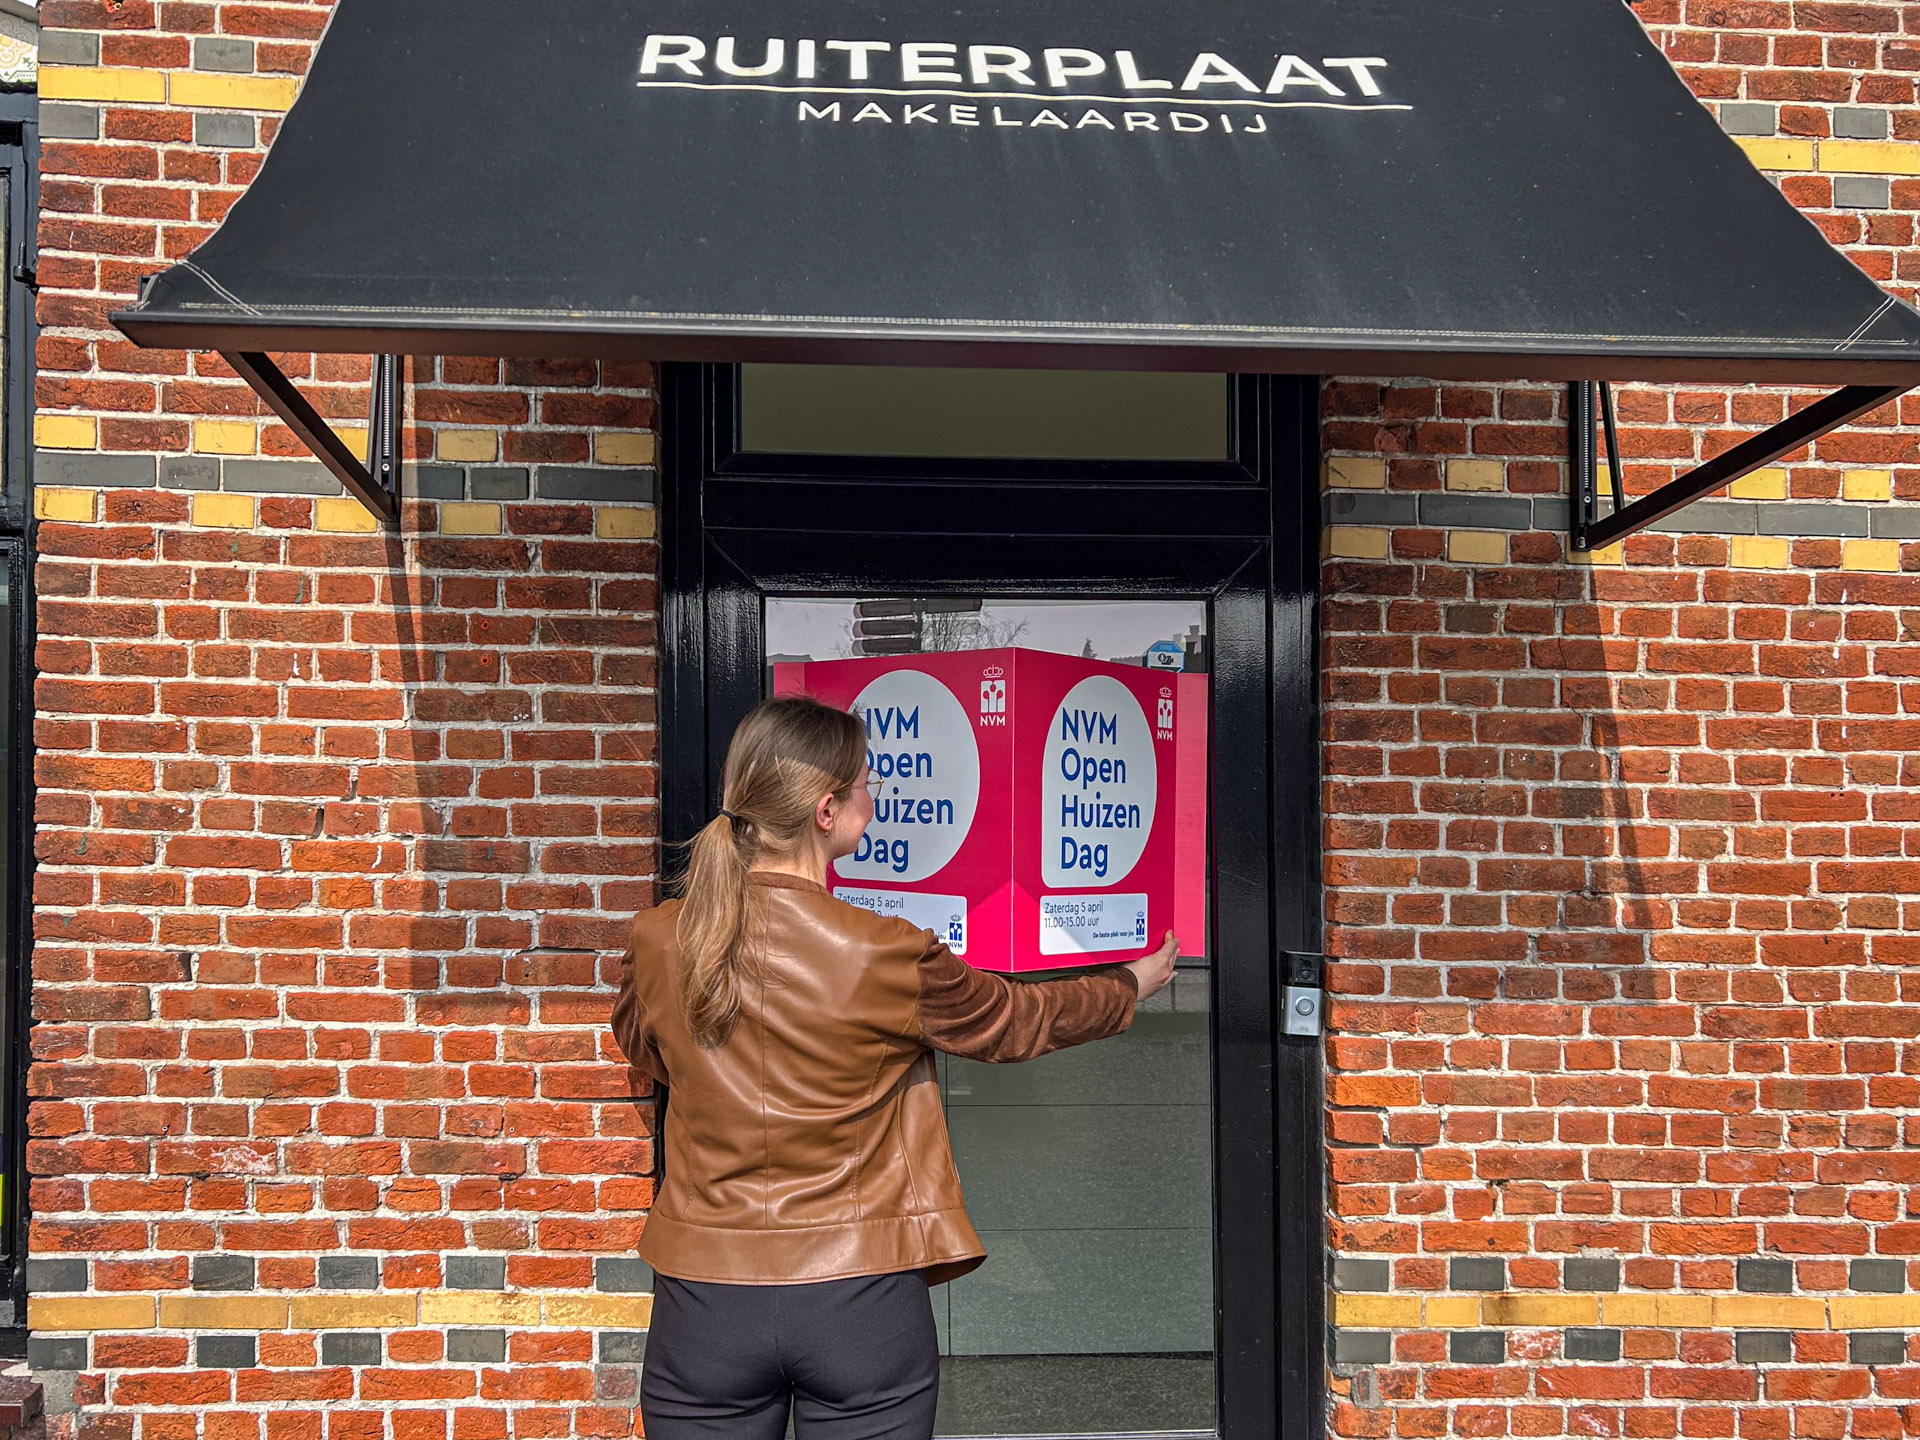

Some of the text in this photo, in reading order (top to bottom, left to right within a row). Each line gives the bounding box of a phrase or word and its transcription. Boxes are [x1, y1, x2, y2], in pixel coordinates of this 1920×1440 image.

[638, 34, 1389, 98] RUITERPLAAT
[798, 101, 1267, 134] MAKELAARDIJ
[1160, 644, 1173, 652] ring
[980, 714, 1006, 727] NVM
[1062, 707, 1117, 745] NVM
[1157, 729, 1173, 741] NVM
[1061, 747, 1126, 790] Open
[874, 787, 954, 824] uizen
[1061, 791, 1140, 829] Huizen
[854, 832, 909, 873] Dag
[1061, 836, 1108, 878] Dag
[877, 897, 883, 907] 5
[885, 897, 904, 910] april
[1044, 901, 1103, 915] Zaterdag 5 april
[1044, 916, 1099, 928] 11.00-15.00 uur
[948, 941, 963, 949] NVM
[1111, 931, 1119, 939] plek
